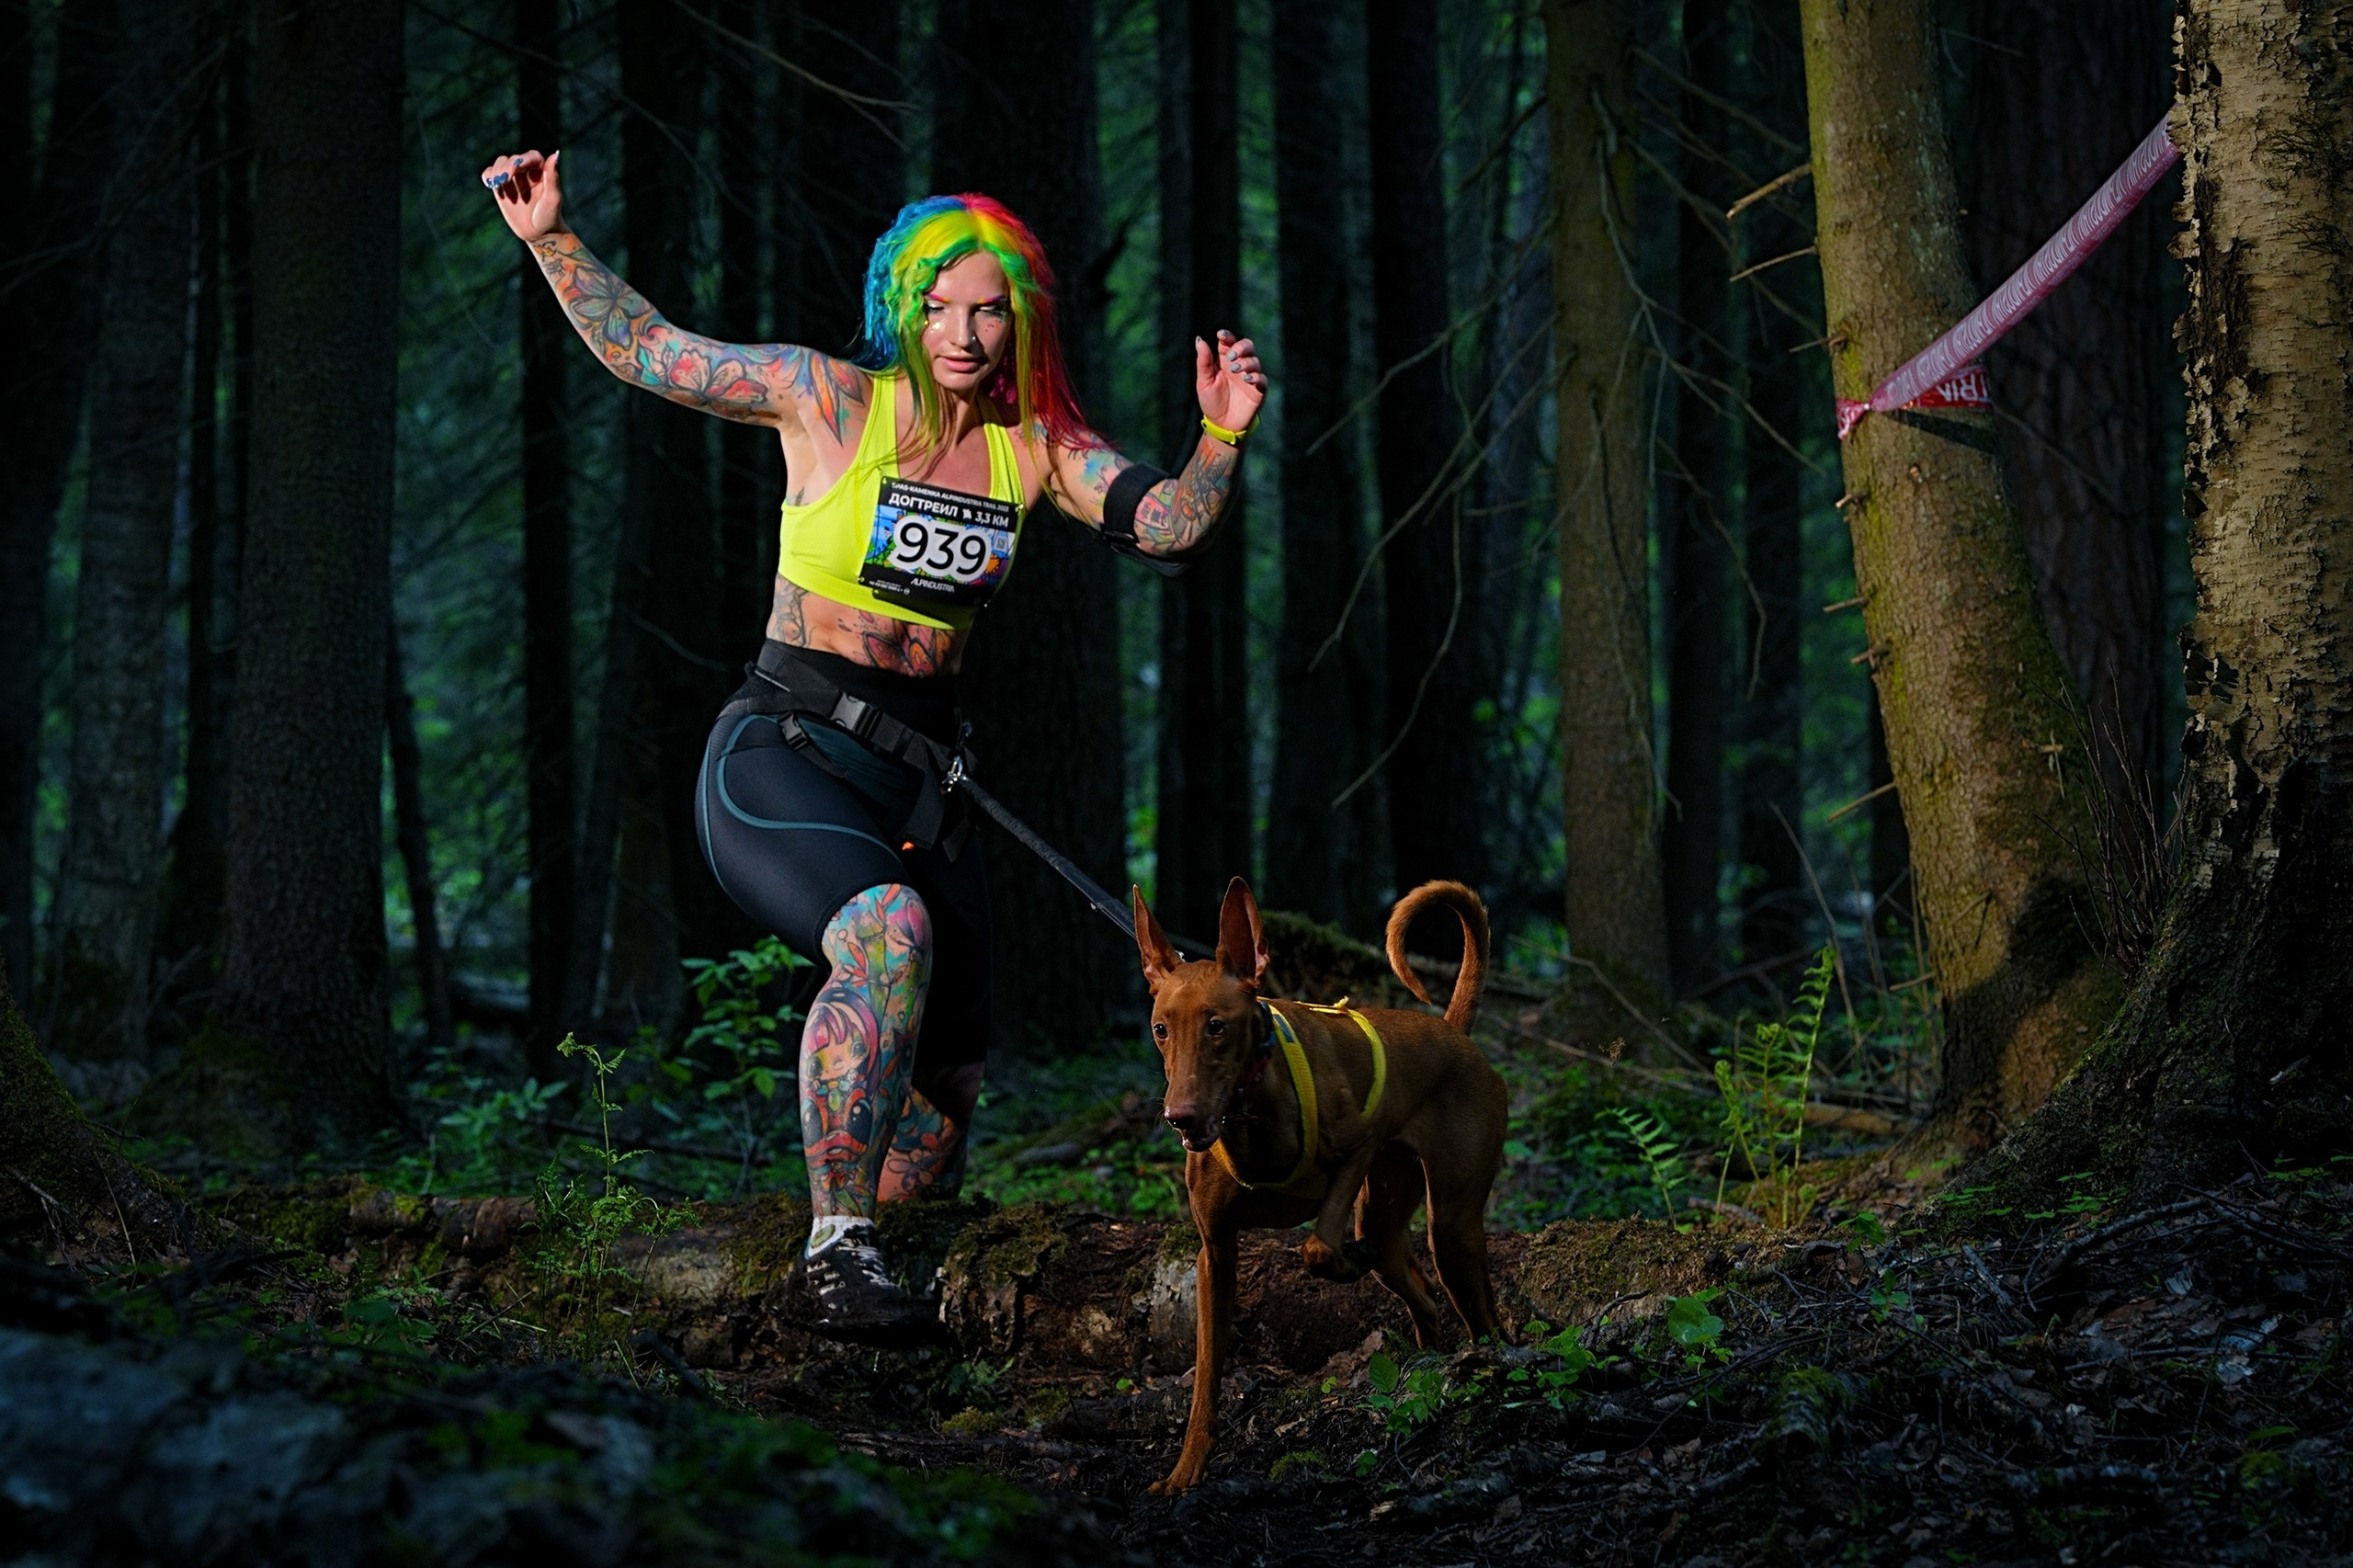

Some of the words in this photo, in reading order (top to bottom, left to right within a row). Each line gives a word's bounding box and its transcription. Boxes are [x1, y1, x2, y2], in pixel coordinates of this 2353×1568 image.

[892, 482, 940, 498] SPAS-KAMENKA
[941, 493, 982, 506] ALPINDUSTRIA
[974, 511, 990, 525] 3,3
[896, 522, 986, 575] 939
[910, 577, 955, 593] ALPINDUSTRIA
